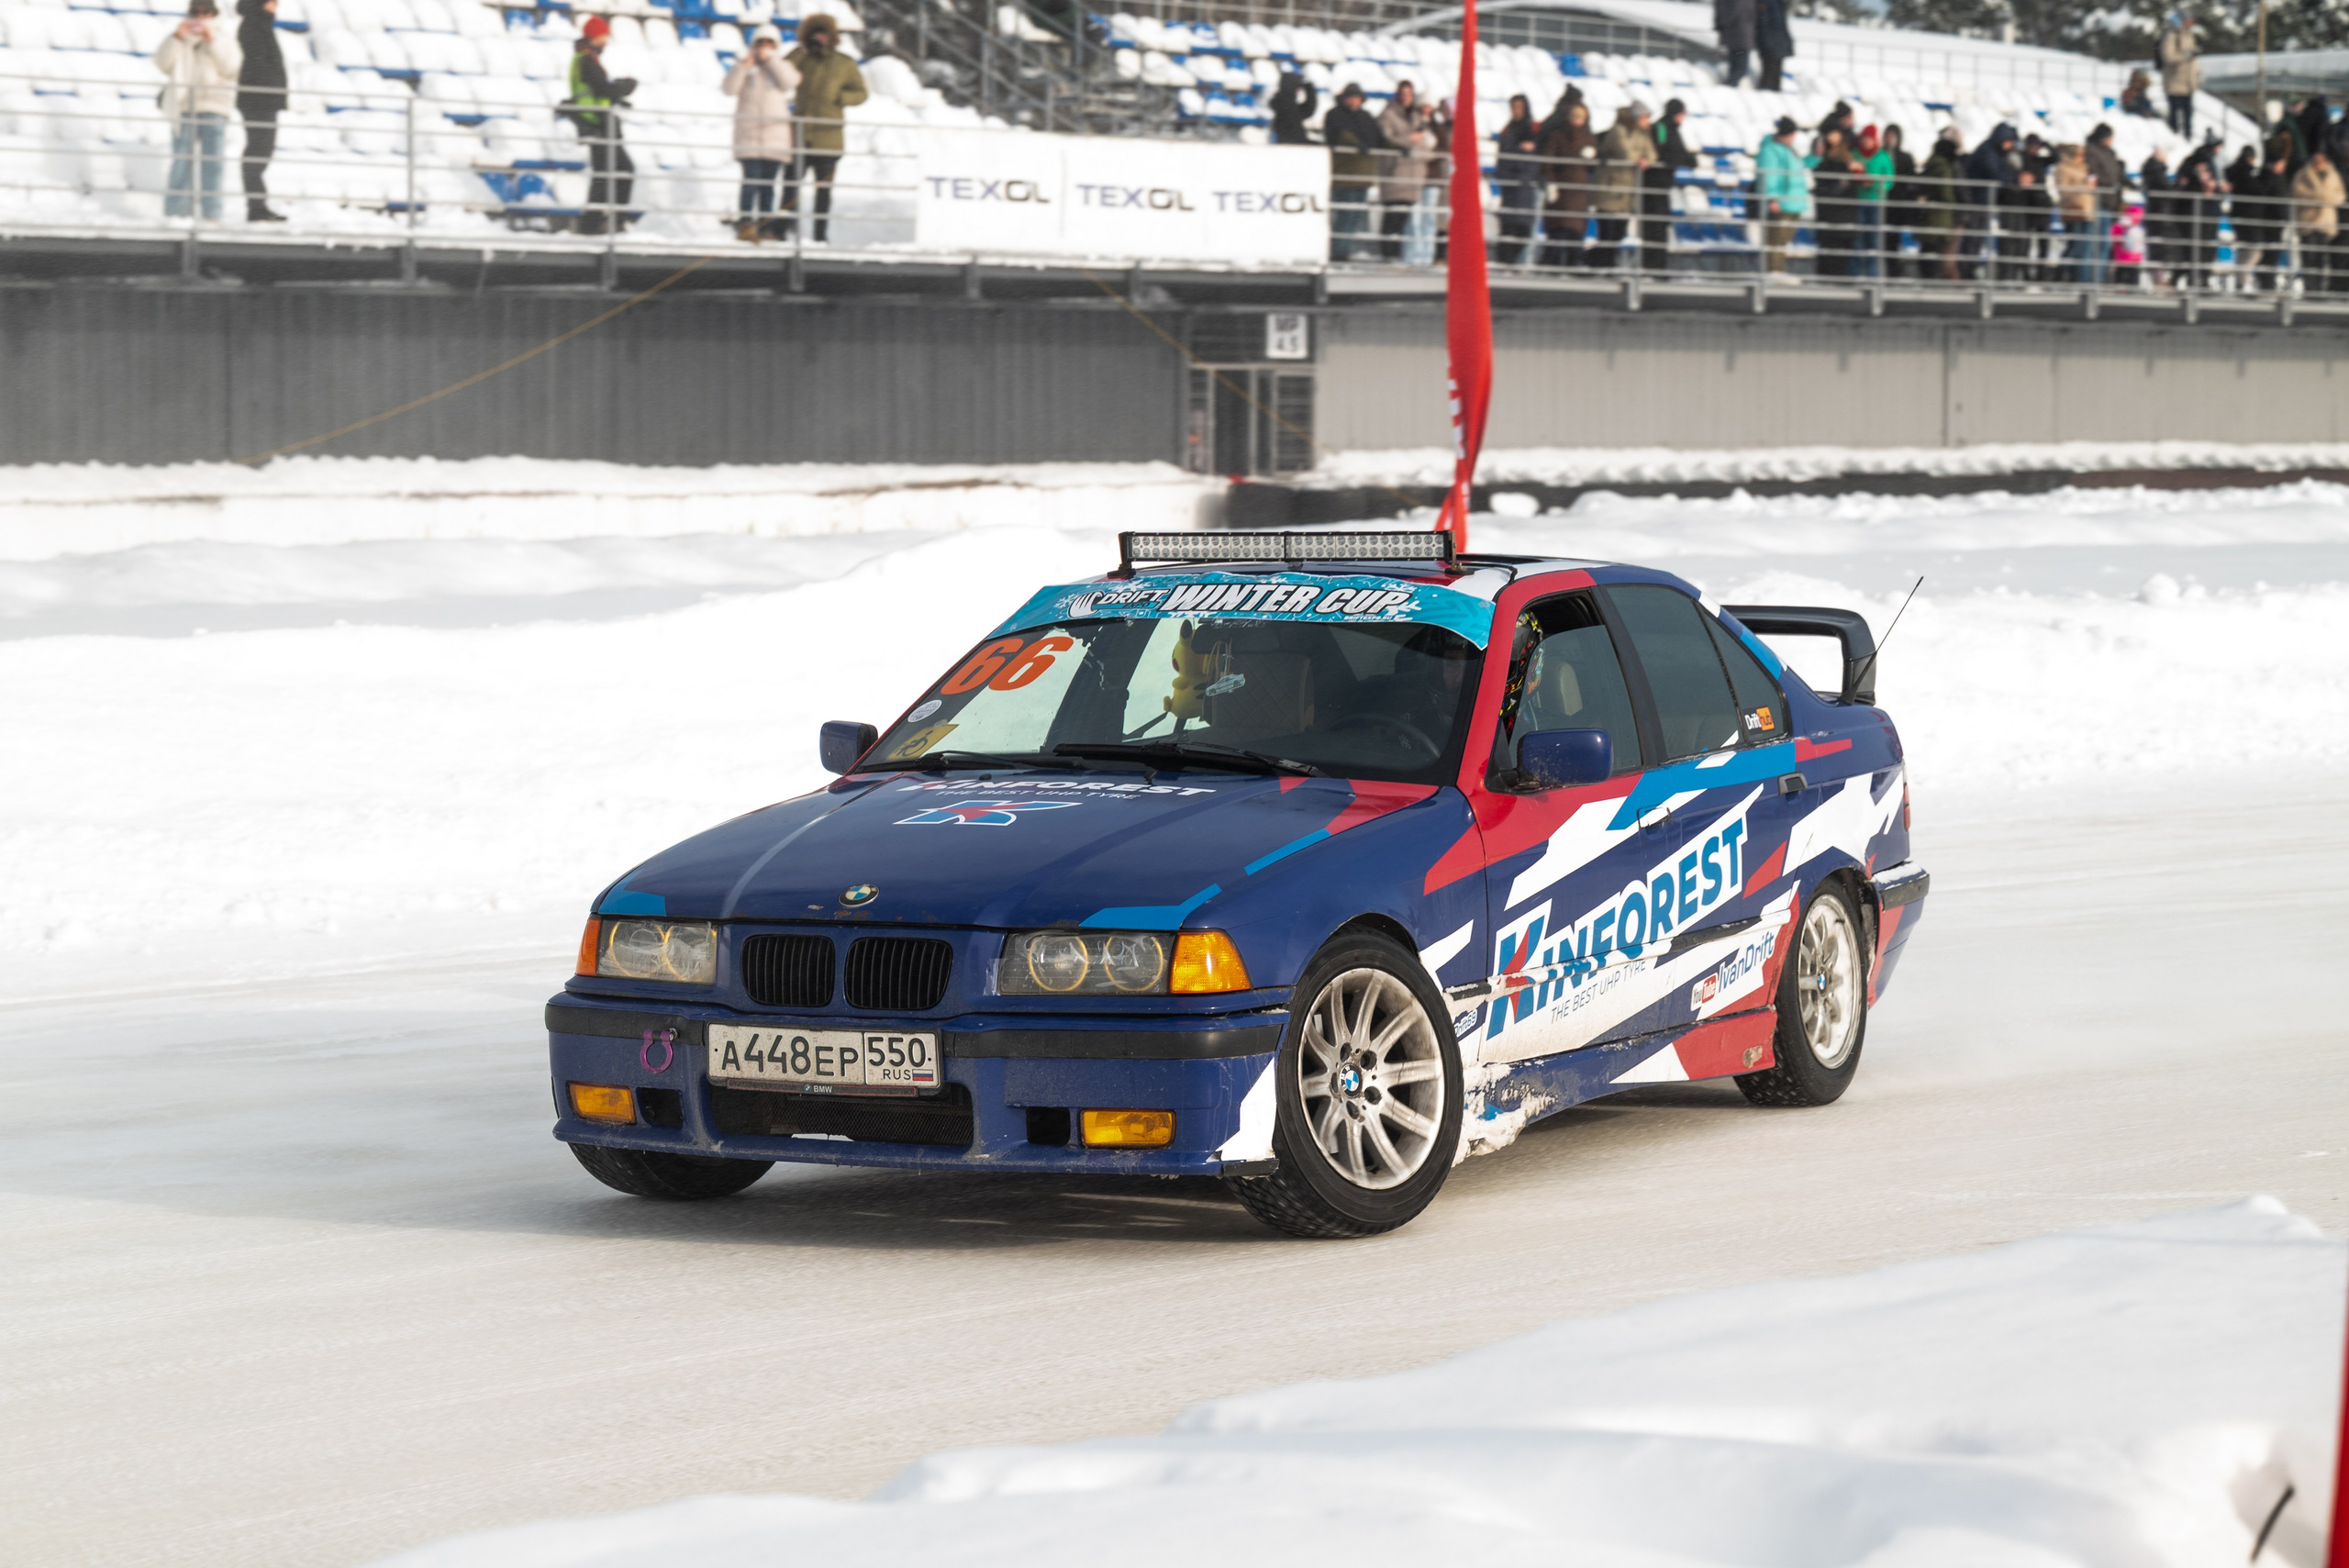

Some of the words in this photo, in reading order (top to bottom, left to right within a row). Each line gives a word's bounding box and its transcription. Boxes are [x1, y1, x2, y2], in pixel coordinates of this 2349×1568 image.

[926, 176, 1050, 204] TEXOL
[1077, 184, 1194, 211] TEXOL
[1213, 191, 1325, 213] TEXOL
[1097, 589, 1170, 605] DRIFT
[1159, 584, 1322, 612] WINTER
[1315, 588, 1411, 614] CUP
[941, 636, 1074, 695] 66
[896, 779, 1217, 796] KINFOREST
[1086, 792, 1141, 800] TYRE
[1486, 817, 1742, 1041] KINFOREST
[1718, 930, 1775, 994] IvanDrift
[1551, 999, 1571, 1024] THE
[1572, 984, 1598, 1012] BEST
[1599, 970, 1621, 995] UHP
[1623, 959, 1646, 982] TYRE
[867, 1037, 927, 1067] 550
[813, 1084, 832, 1094] BMW
[883, 1069, 911, 1081] RUS
